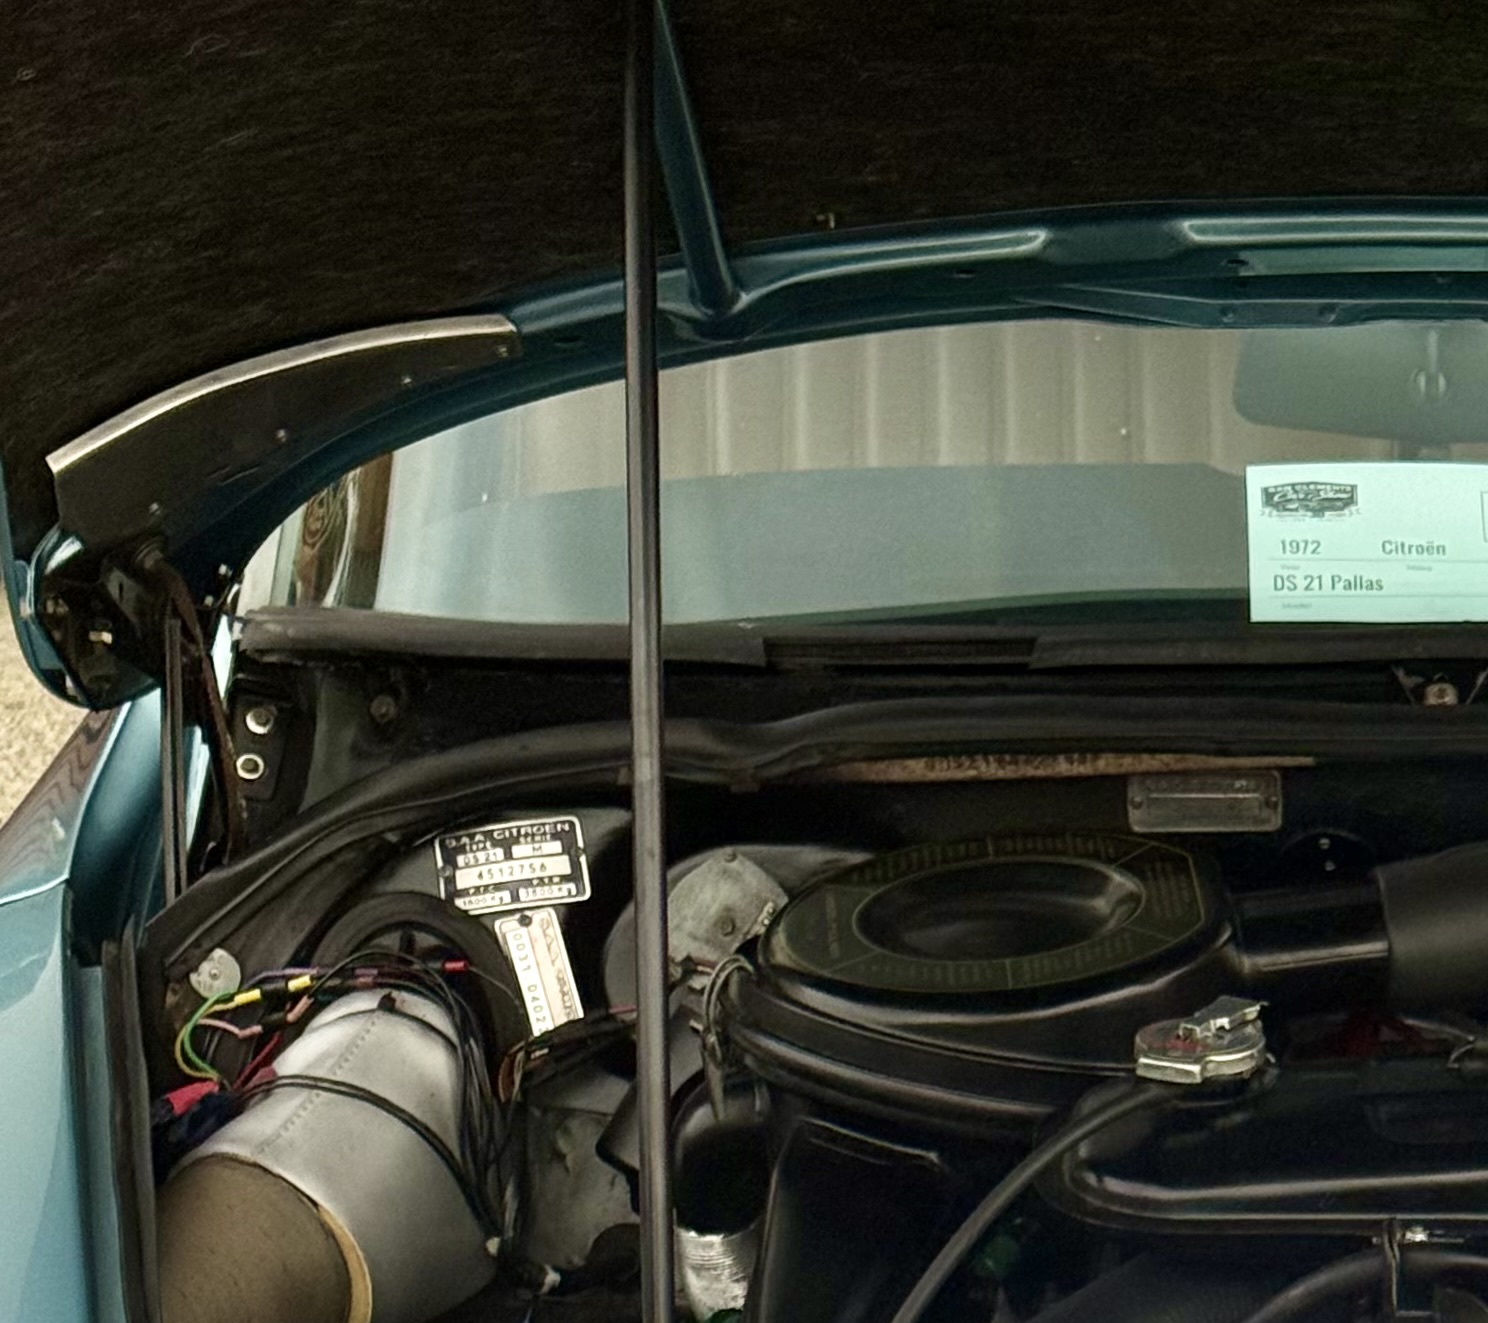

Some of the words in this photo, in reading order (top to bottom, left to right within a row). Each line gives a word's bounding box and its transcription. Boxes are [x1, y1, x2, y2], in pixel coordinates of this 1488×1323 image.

[1280, 539, 1322, 555] 1972
[1381, 539, 1447, 556] Citroën
[1273, 575, 1298, 592] DS
[1303, 574, 1324, 591] 21
[1331, 574, 1384, 592] Pallas
